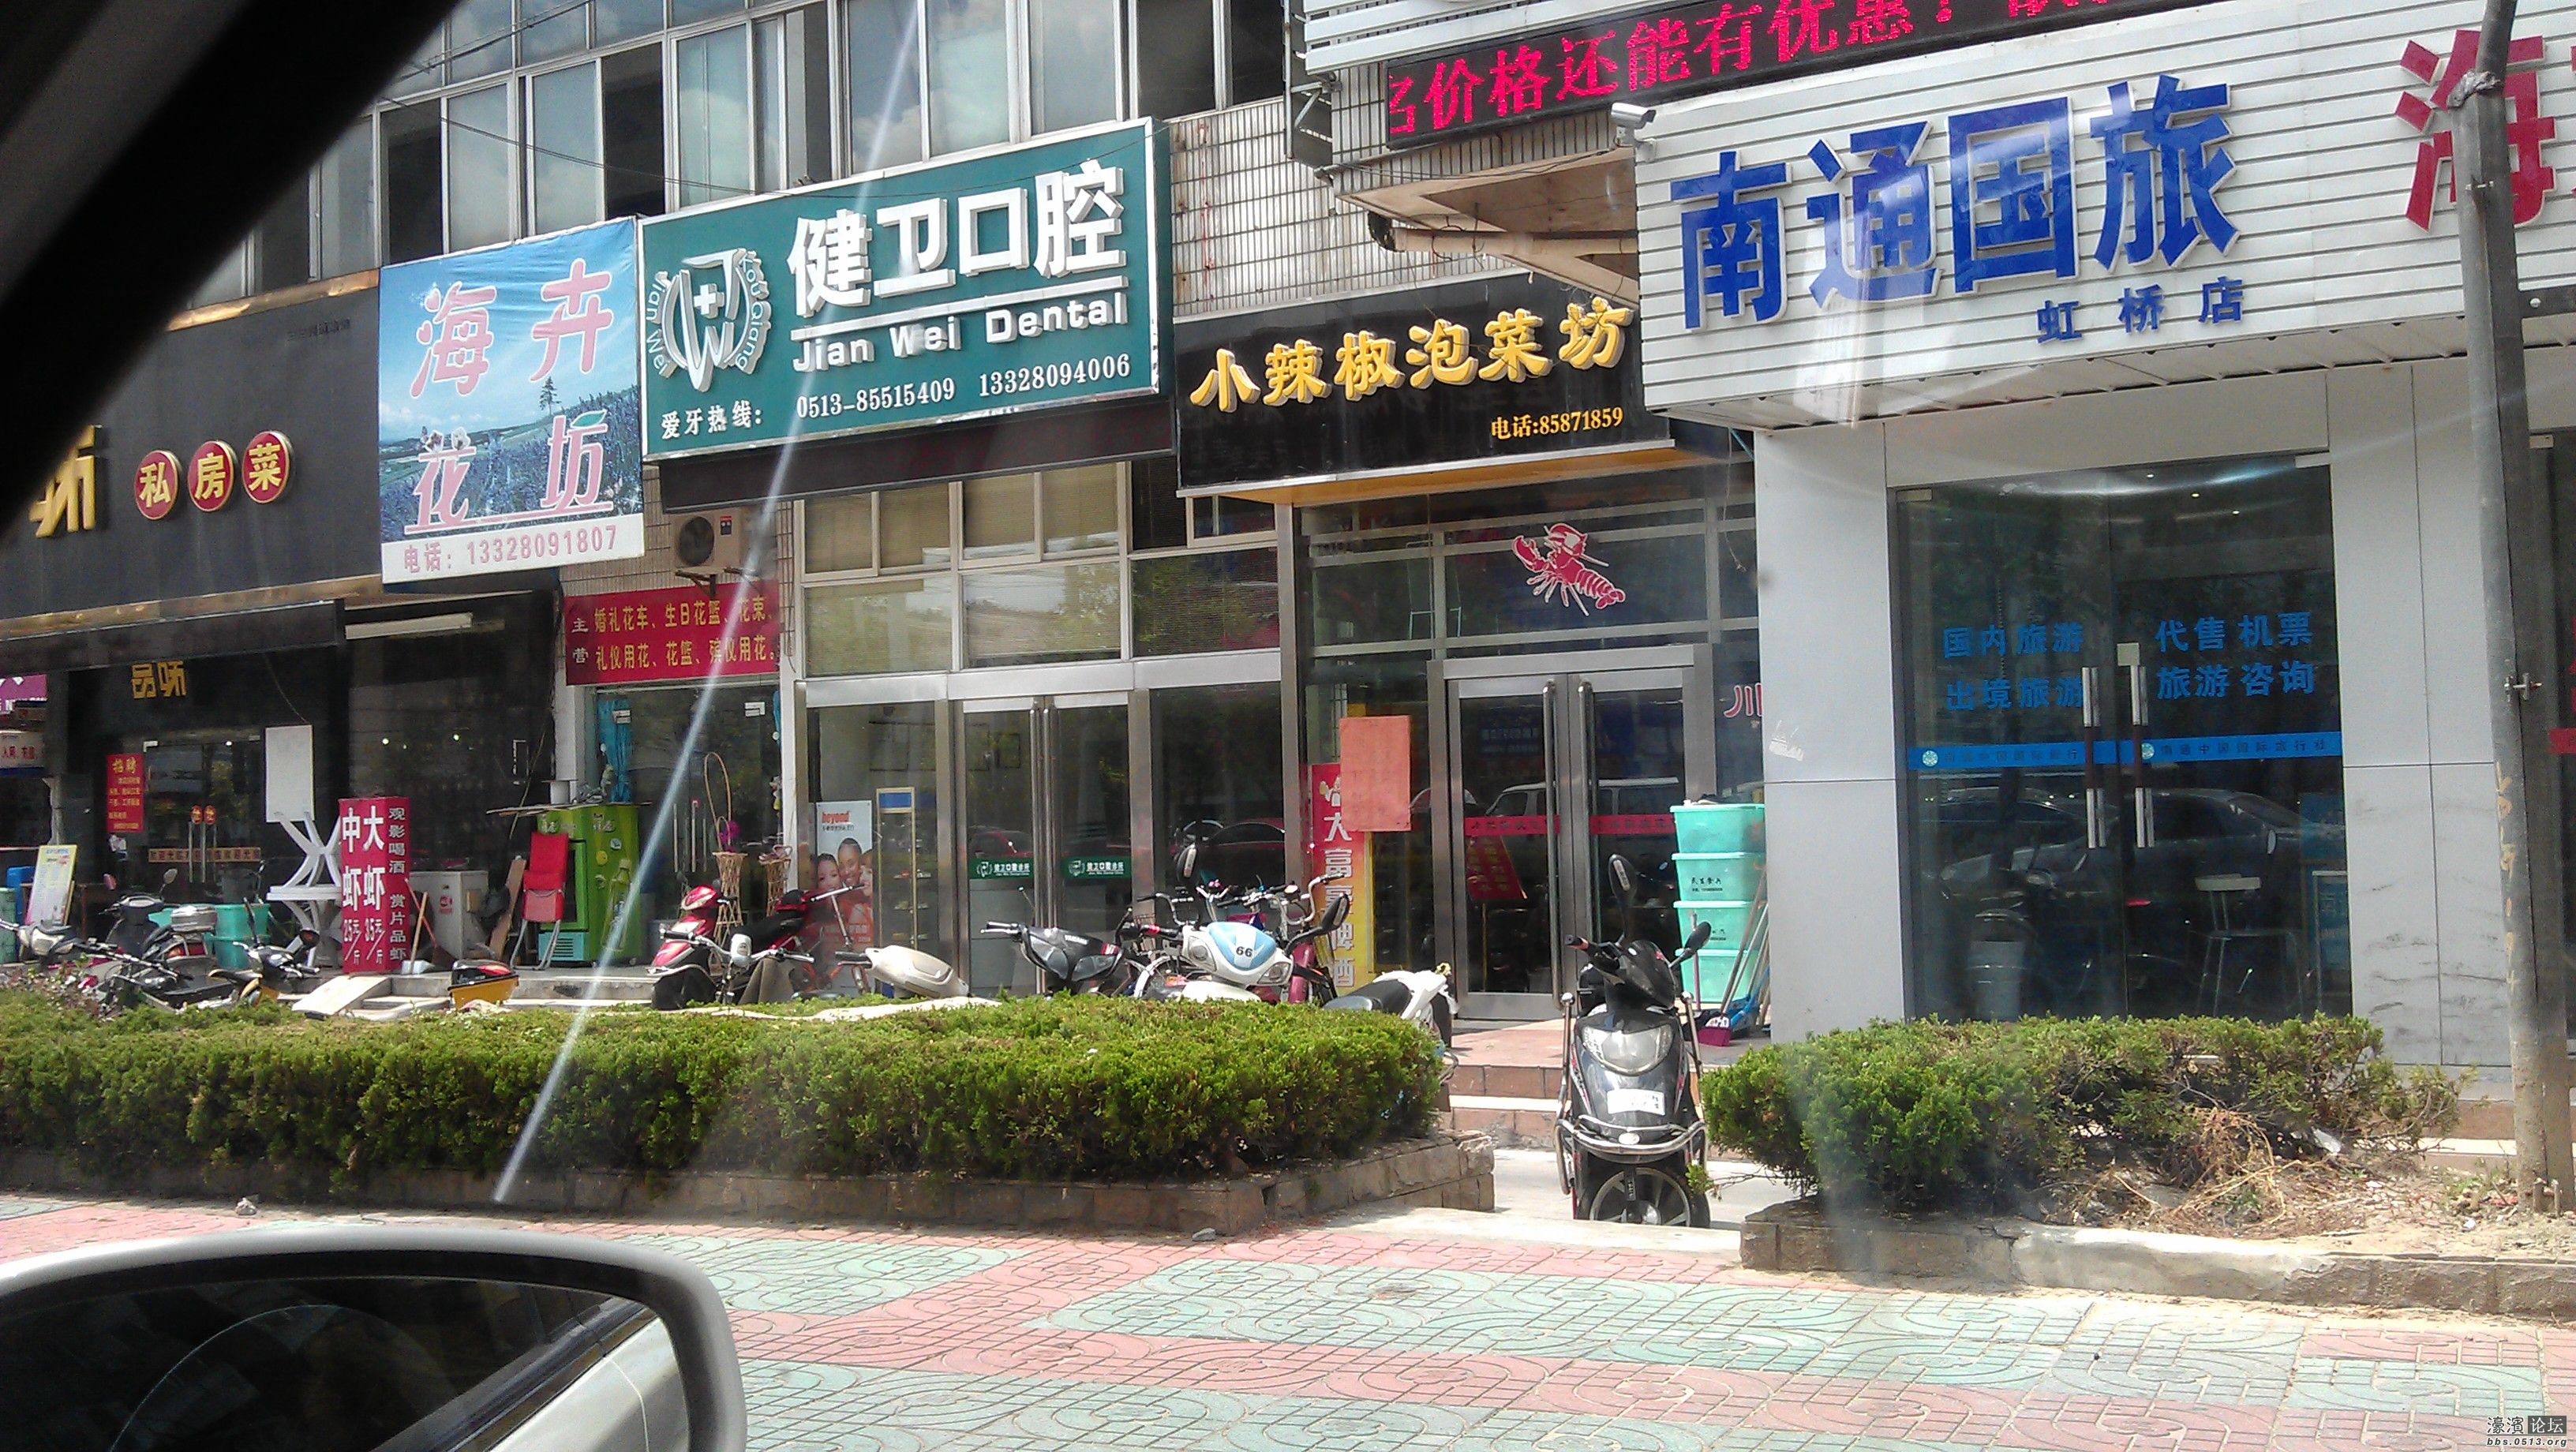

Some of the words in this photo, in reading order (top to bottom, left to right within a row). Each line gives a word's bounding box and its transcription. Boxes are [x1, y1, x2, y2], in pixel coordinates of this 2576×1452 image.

[2394, 28, 2576, 234] 海
[1670, 73, 2240, 331] 南通国旅
[787, 159, 1127, 317] 健卫口腔
[410, 258, 614, 399] 海卉
[792, 335, 875, 372] Jian
[889, 316, 962, 359] Wei
[986, 292, 1129, 344] Dental
[2036, 275, 2245, 345] 虹桥店
[796, 377, 956, 420] 0513-85515409
[979, 354, 1131, 398] 13328094006
[1189, 297, 1634, 414] 小辣椒泡菜坊
[1491, 407, 1624, 440] 电话:85871859
[140, 442, 281, 508] 私房菜
[404, 410, 614, 535] 花坊
[571, 618, 589, 664] 主营
[1944, 622, 2084, 659] 国内旅游
[2155, 611, 2313, 653] 代售机票
[1946, 676, 2084, 710] 出境旅游
[2156, 660, 2316, 699] 旅游咨询
[1945, 747, 2079, 764] 南通中国国际旅行
[343, 806, 361, 911] 中虾
[363, 805, 385, 911] 大虾
[388, 807, 406, 874] 观影喝酒
[389, 894, 406, 960] 赏片品虾
[1236, 946, 1253, 957] 66
